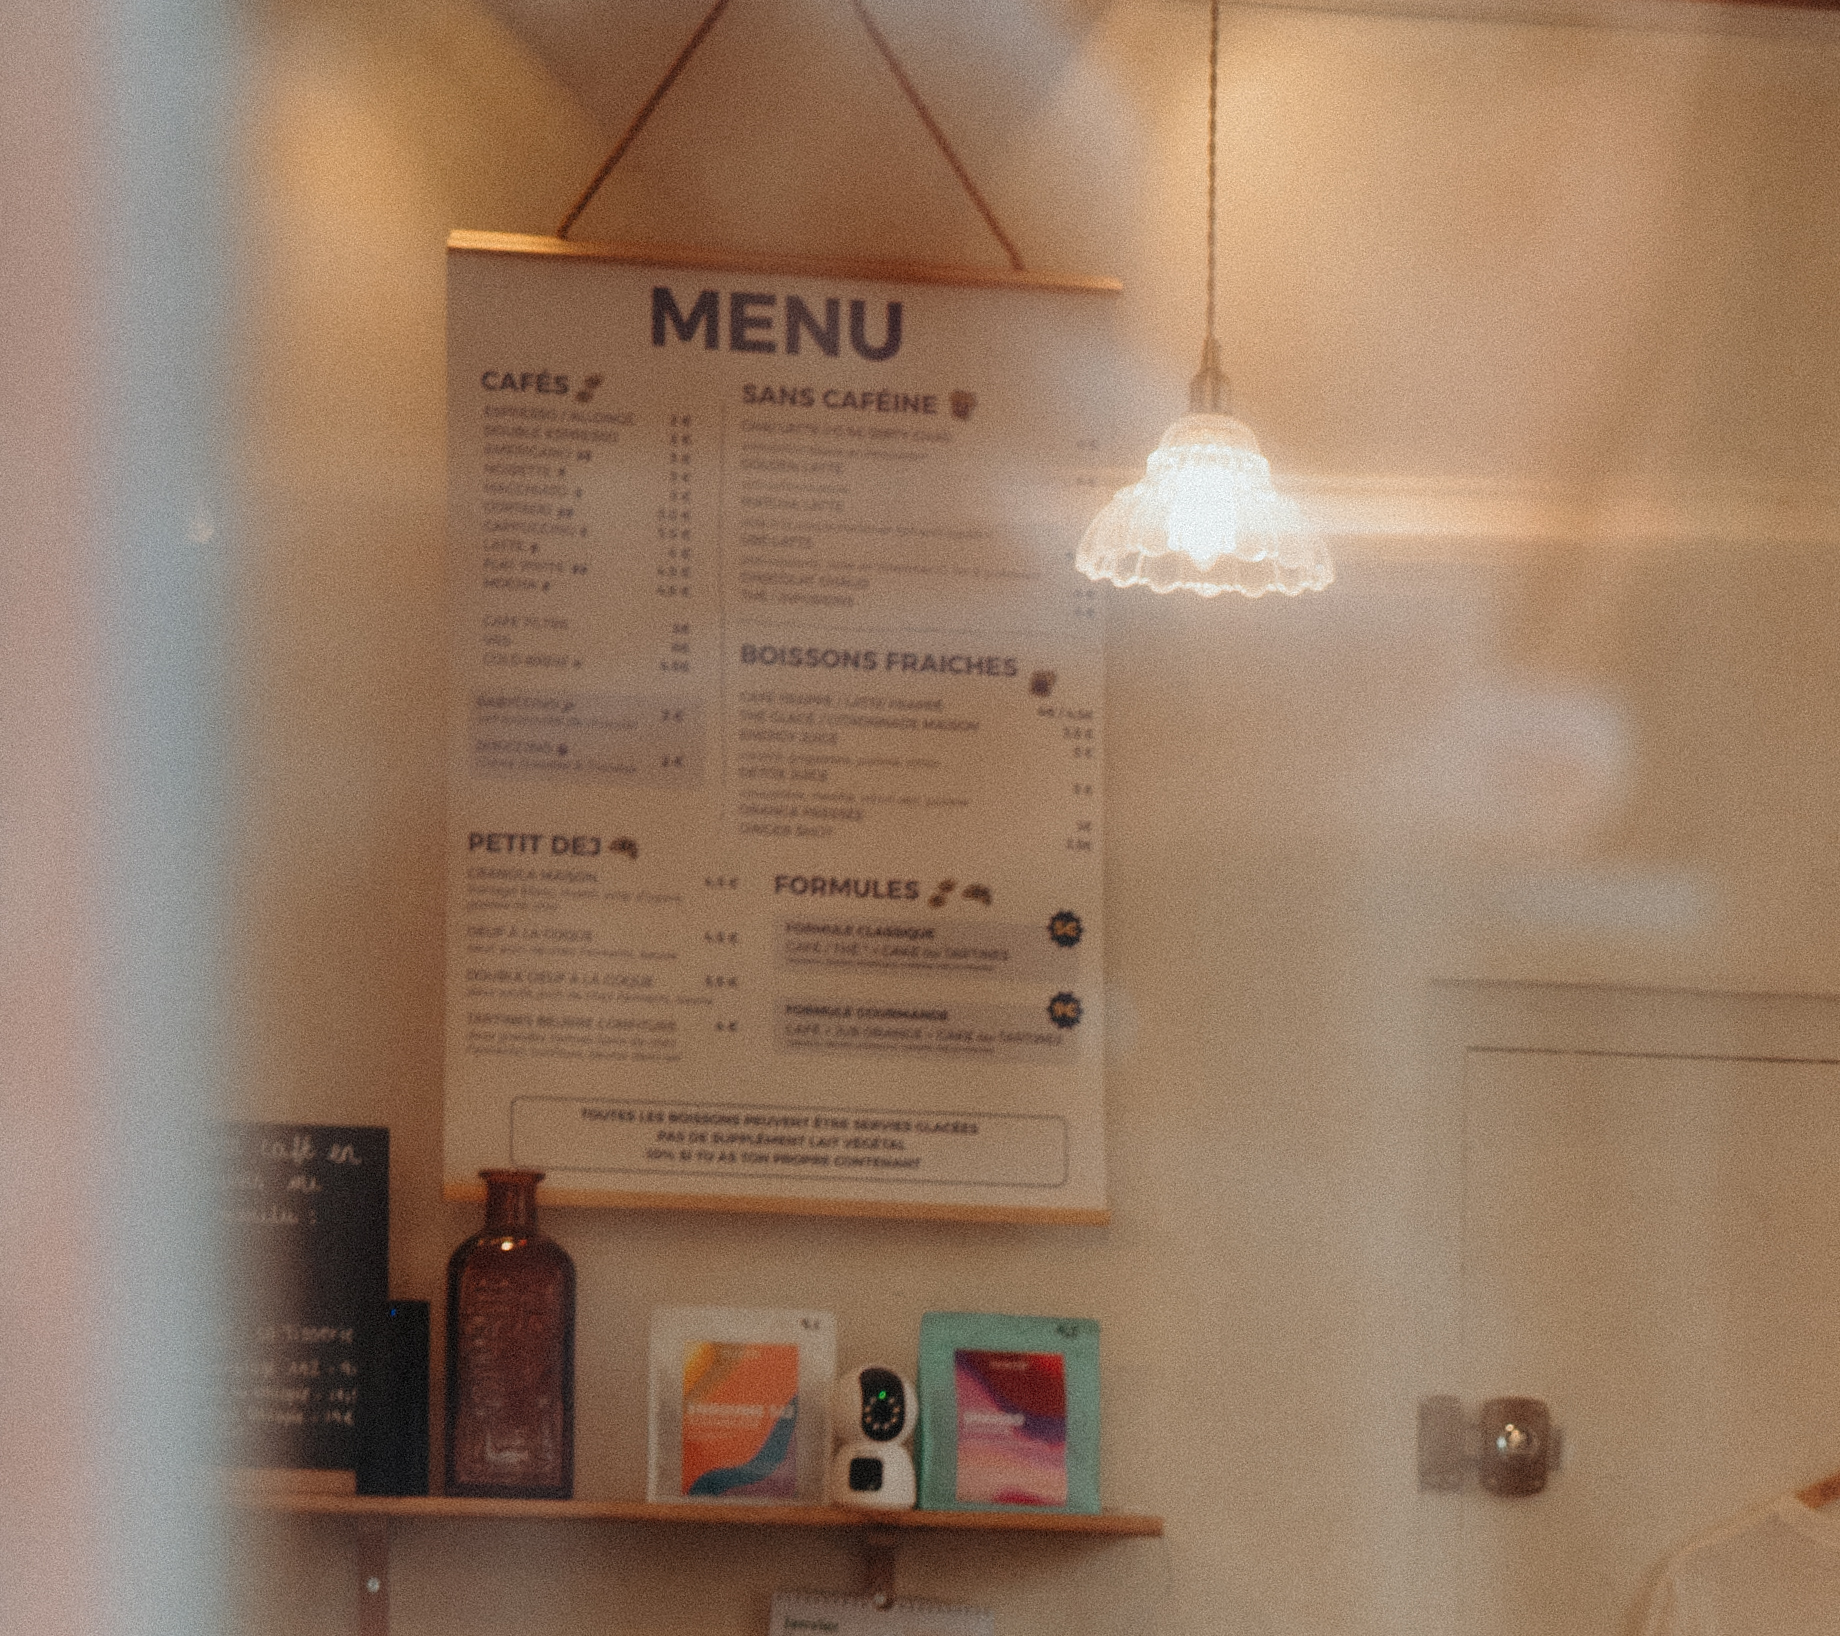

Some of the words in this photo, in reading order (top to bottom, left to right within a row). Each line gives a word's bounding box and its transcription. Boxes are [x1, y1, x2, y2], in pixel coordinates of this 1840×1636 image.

[652, 285, 903, 363] MENU
[480, 369, 569, 395] CAFÉS
[742, 383, 814, 408] SANS
[822, 388, 938, 415] CAFÉINE
[740, 643, 878, 673] BOISSONS
[885, 650, 1019, 678] FRAICHES
[468, 831, 543, 854] PETIT
[551, 834, 601, 858] DEJ
[774, 874, 921, 901] FORMULES
